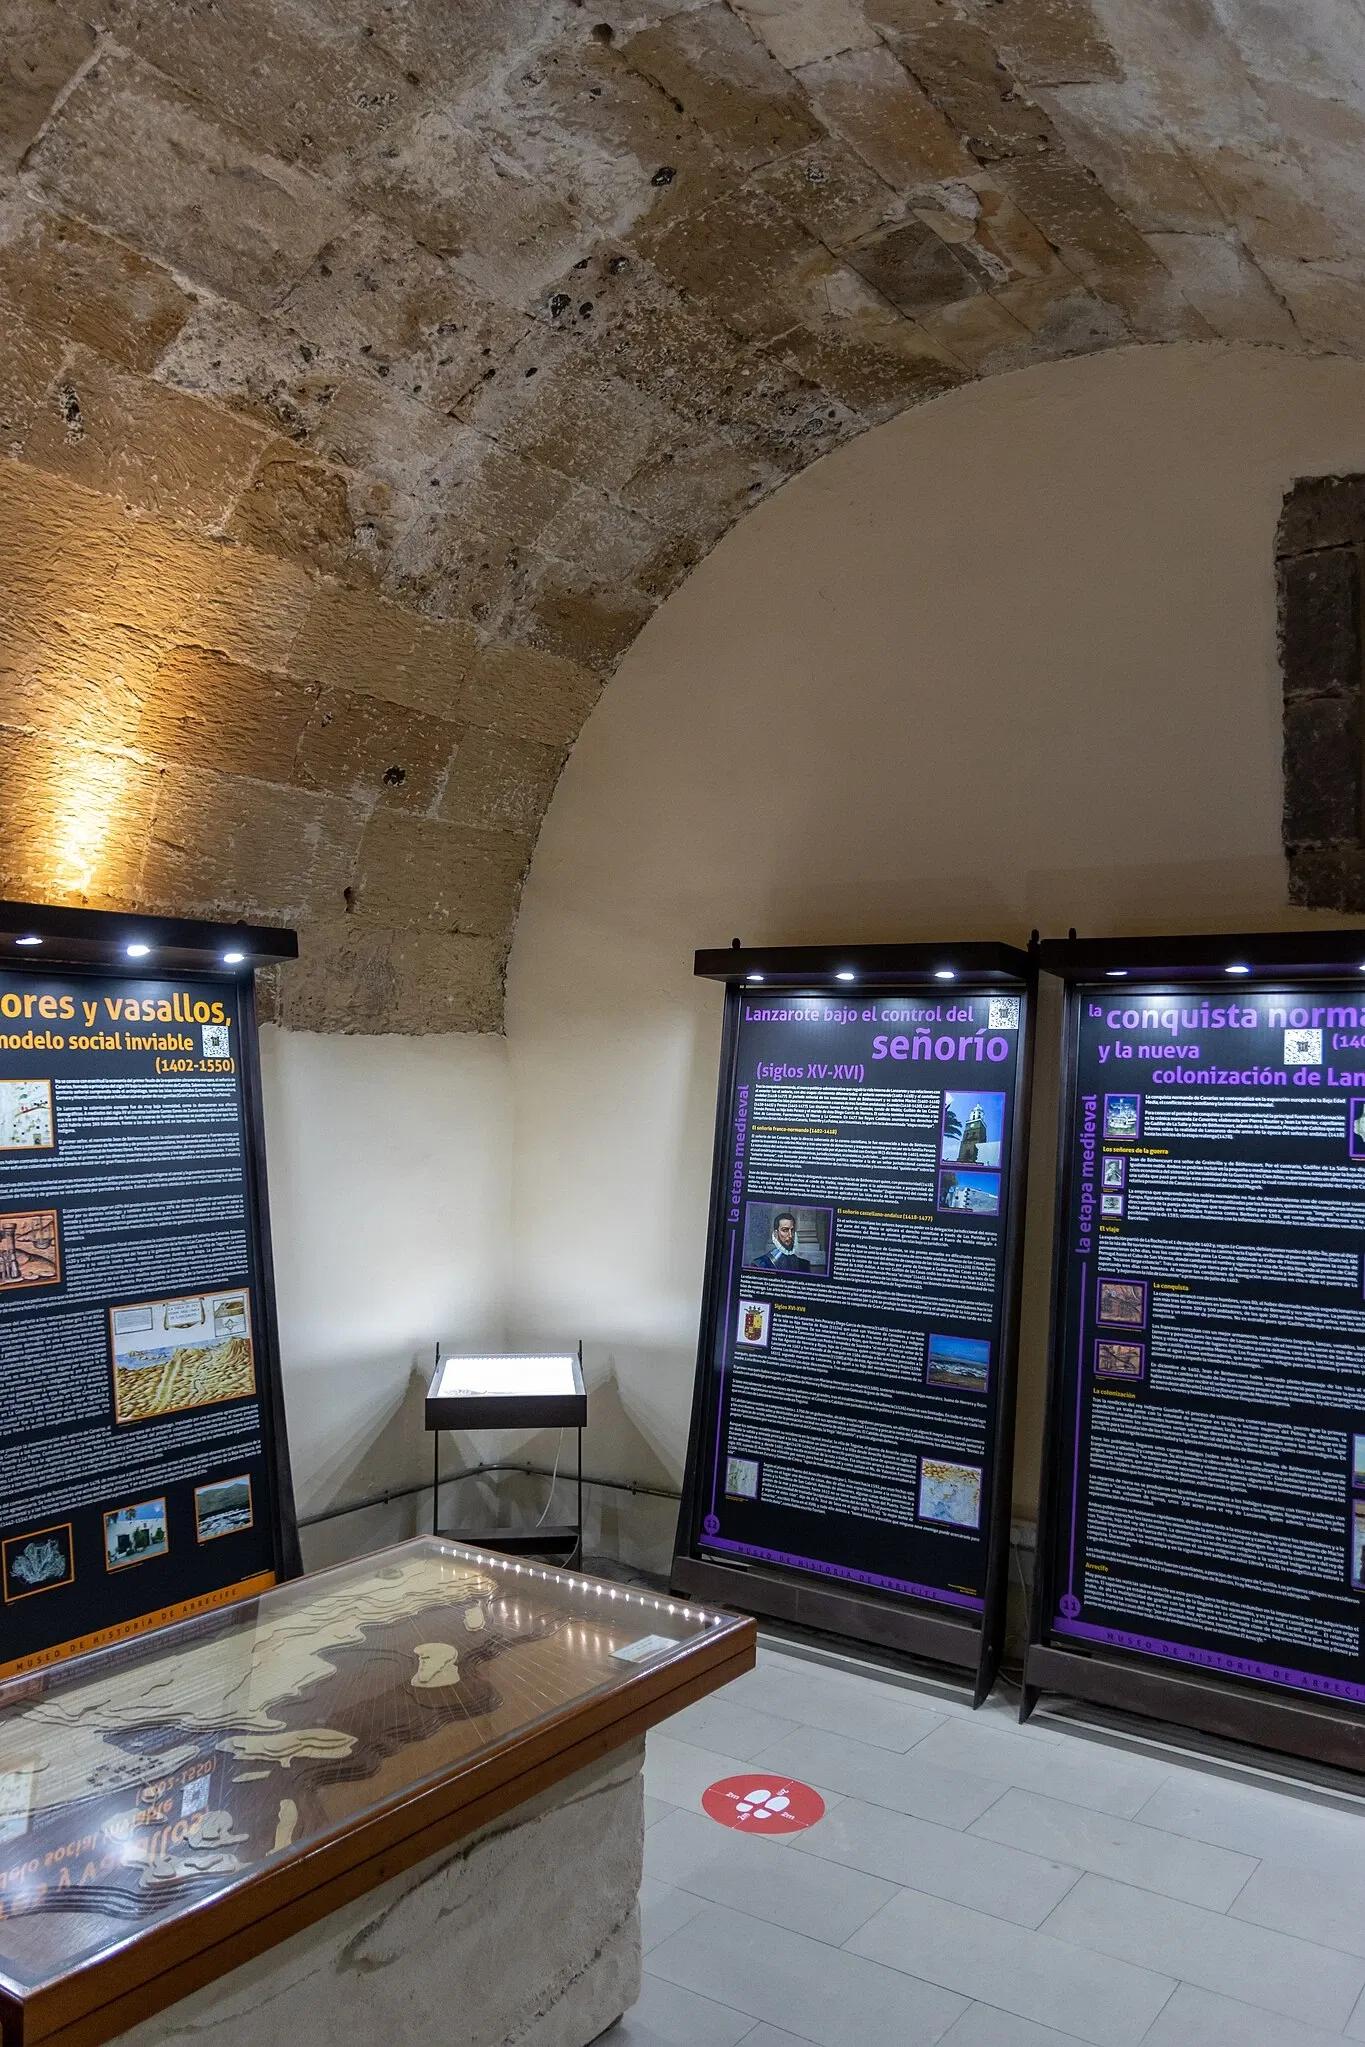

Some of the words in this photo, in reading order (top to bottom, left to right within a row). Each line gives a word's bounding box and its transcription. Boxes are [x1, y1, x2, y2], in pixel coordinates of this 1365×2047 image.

[0, 993, 76, 1019] ores
[82, 1001, 98, 1027] y
[104, 993, 231, 1026] vasallos,
[745, 1006, 820, 1022] Lanzarote
[823, 1006, 858, 1025] bajo
[862, 1007, 877, 1021] el
[881, 1006, 942, 1022] control
[945, 1006, 974, 1022] del
[1089, 1004, 1102, 1017] la
[1106, 1002, 1258, 1036] conquista
[69, 1032, 122, 1050] social
[124, 1033, 194, 1051] inviable
[872, 1028, 1009, 1062] señorío
[1098, 1044, 1110, 1063] y
[1115, 1041, 1133, 1059] la
[1138, 1045, 1200, 1059] nueva
[155, 1057, 235, 1074] (1402-1550)
[756, 1062, 804, 1082] (siglos
[807, 1064, 865, 1082] XV-XVI)
[1152, 1066, 1287, 1085] colonización
[1292, 1067, 1321, 1086] de
[735, 1084, 749, 1157] medieval
[1079, 1094, 1097, 1178] medieval
[731, 1161, 745, 1204] etapa
[727, 1208, 740, 1223] la
[1079, 1182, 1096, 1233] etapa
[1075, 1237, 1091, 1254] la
[1101, 1390, 1136, 1398] colonización
[707, 1520, 717, 1529] 12
[1085, 1562, 1108, 1572] Arrecife
[799, 1560, 851, 1578] HISTORIA
[860, 1575, 872, 1583] DE
[880, 1580, 936, 1599] ARRECIFE
[1063, 1600, 1076, 1611] 11
[16, 1650, 61, 1671] MUSEO
[70, 1641, 84, 1652] DE
[93, 1618, 153, 1644] HISTORIA
[162, 1609, 175, 1620] DE
[182, 1588, 237, 1613] ARRECIFE
[1107, 1632, 1152, 1648] MUSEO
[1162, 1646, 1178, 1655] DE
[1189, 1652, 1261, 1674] HISTORIA
[1273, 1670, 1291, 1681] DE
